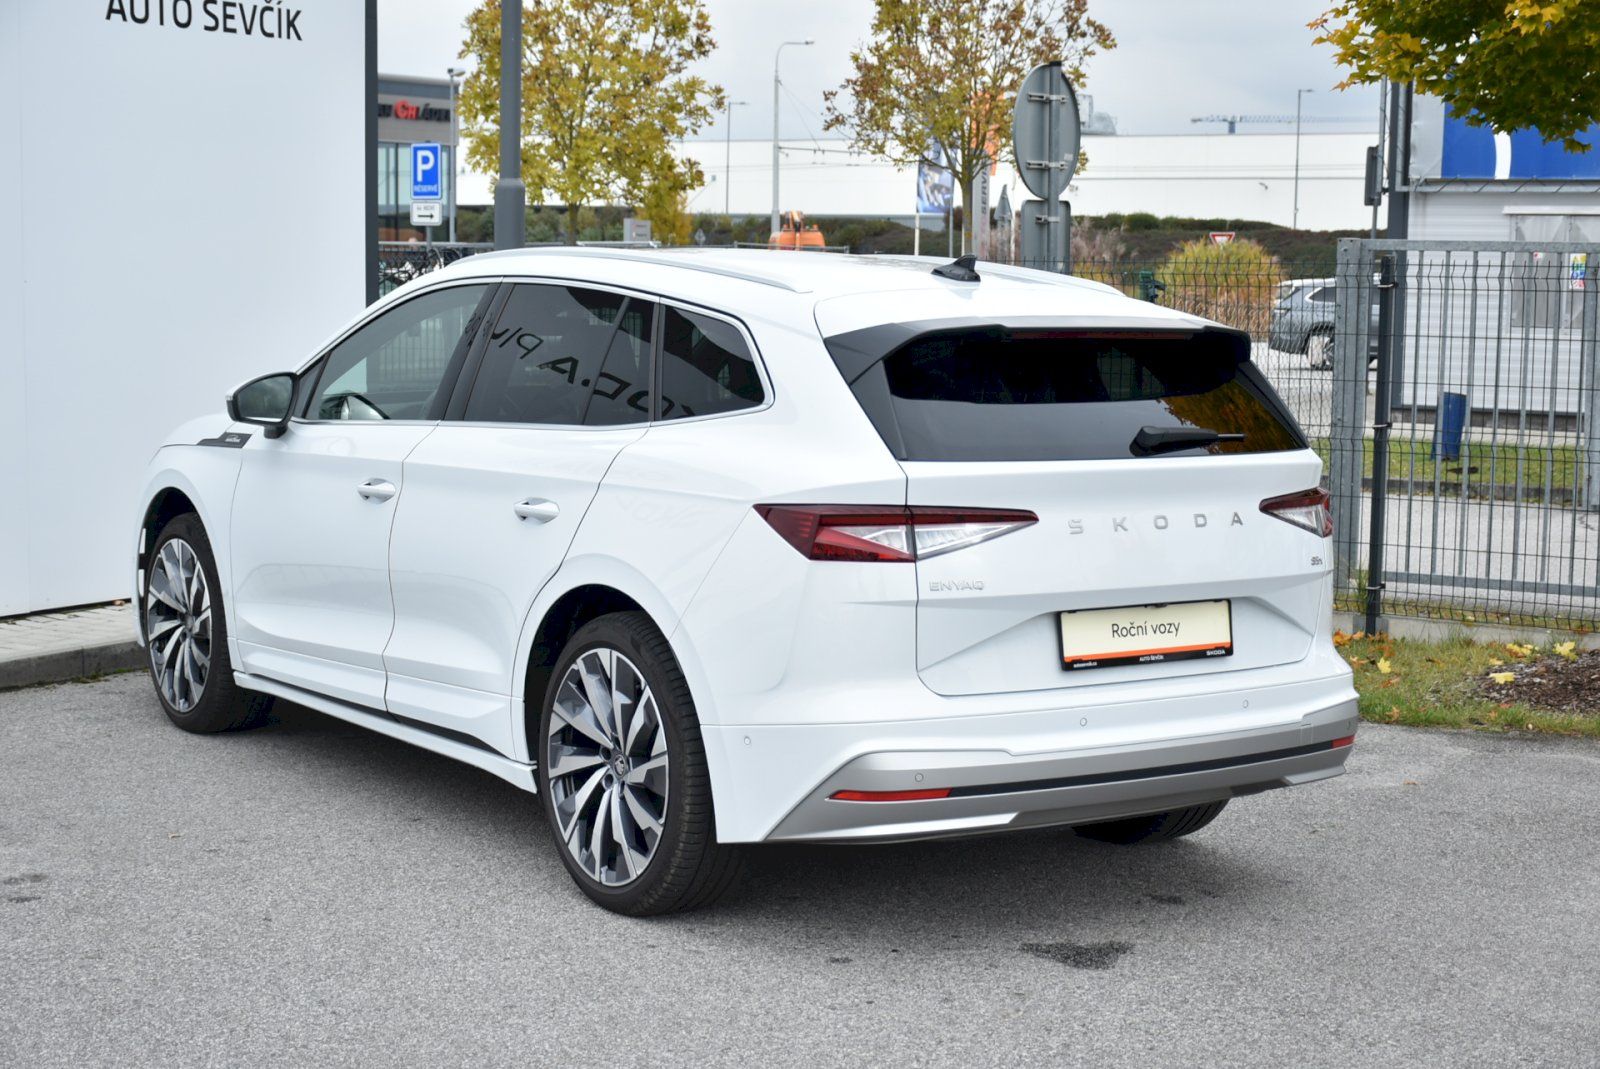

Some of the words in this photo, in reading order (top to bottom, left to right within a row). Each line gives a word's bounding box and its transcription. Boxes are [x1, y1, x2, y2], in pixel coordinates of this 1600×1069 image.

[105, 0, 193, 29] AUTO
[416, 150, 435, 182] P
[1111, 621, 1148, 638] Roční
[1151, 622, 1180, 637] vozy
